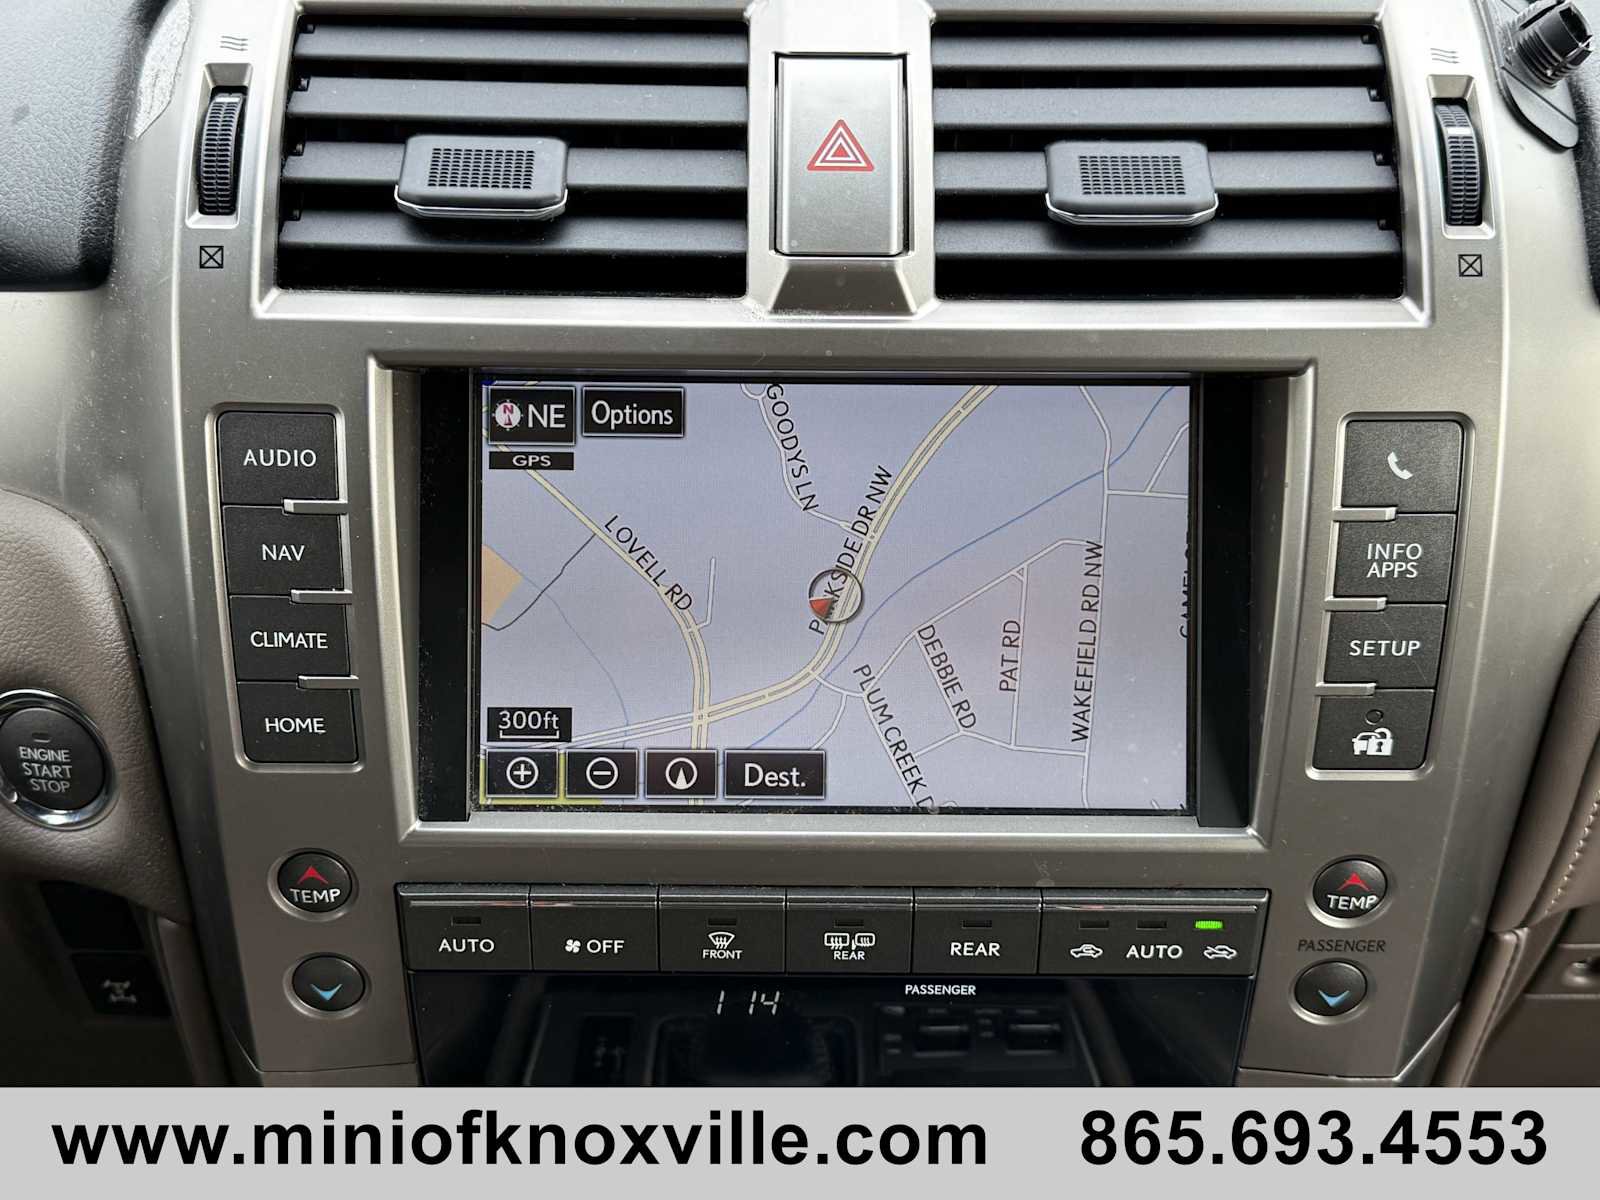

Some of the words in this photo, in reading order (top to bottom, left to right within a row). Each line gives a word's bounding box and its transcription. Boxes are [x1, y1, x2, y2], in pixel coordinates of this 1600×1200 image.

[527, 403, 567, 428] NE
[591, 400, 674, 430] Options
[766, 383, 809, 480] GOODYS
[795, 481, 819, 512] LN
[243, 449, 317, 467] AUDIO
[512, 454, 551, 468] GPS
[261, 544, 305, 560] NAV
[808, 537, 863, 635] PKSIDE
[851, 505, 876, 537] DR
[865, 465, 893, 504] NW
[1366, 543, 1422, 560] INFO
[604, 515, 667, 587] LOVELL
[664, 583, 693, 611] RD
[1083, 540, 1104, 579] NW
[1366, 562, 1418, 578] APPS
[1080, 585, 1100, 612] RD
[250, 631, 328, 649] CLIMATE
[1003, 619, 1020, 648] RD
[1349, 640, 1421, 656] SETUP
[918, 624, 962, 699] DEBBIE
[952, 699, 977, 730] RD
[999, 651, 1018, 692] PAT
[1072, 618, 1098, 742] WAKEFIELD
[264, 717, 326, 734] HOME
[498, 710, 560, 730] 300ft
[852, 664, 895, 727] PLUM
[883, 725, 928, 797] CREEK
[18, 746, 71, 762] ENGINE
[22, 762, 72, 778] START
[744, 763, 806, 788] Dest.
[30, 778, 70, 792] STOP
[289, 888, 341, 904] TEMP
[1326, 894, 1378, 911] TEMP
[438, 938, 495, 954] AUTO
[586, 939, 624, 955] OFF
[950, 942, 1000, 957] REAR
[1126, 944, 1183, 960] AUTO
[1297, 938, 1387, 953] PASSENGER
[702, 949, 742, 960] FRONT
[833, 951, 865, 961] REAR
[904, 984, 977, 997] PASSENGER
